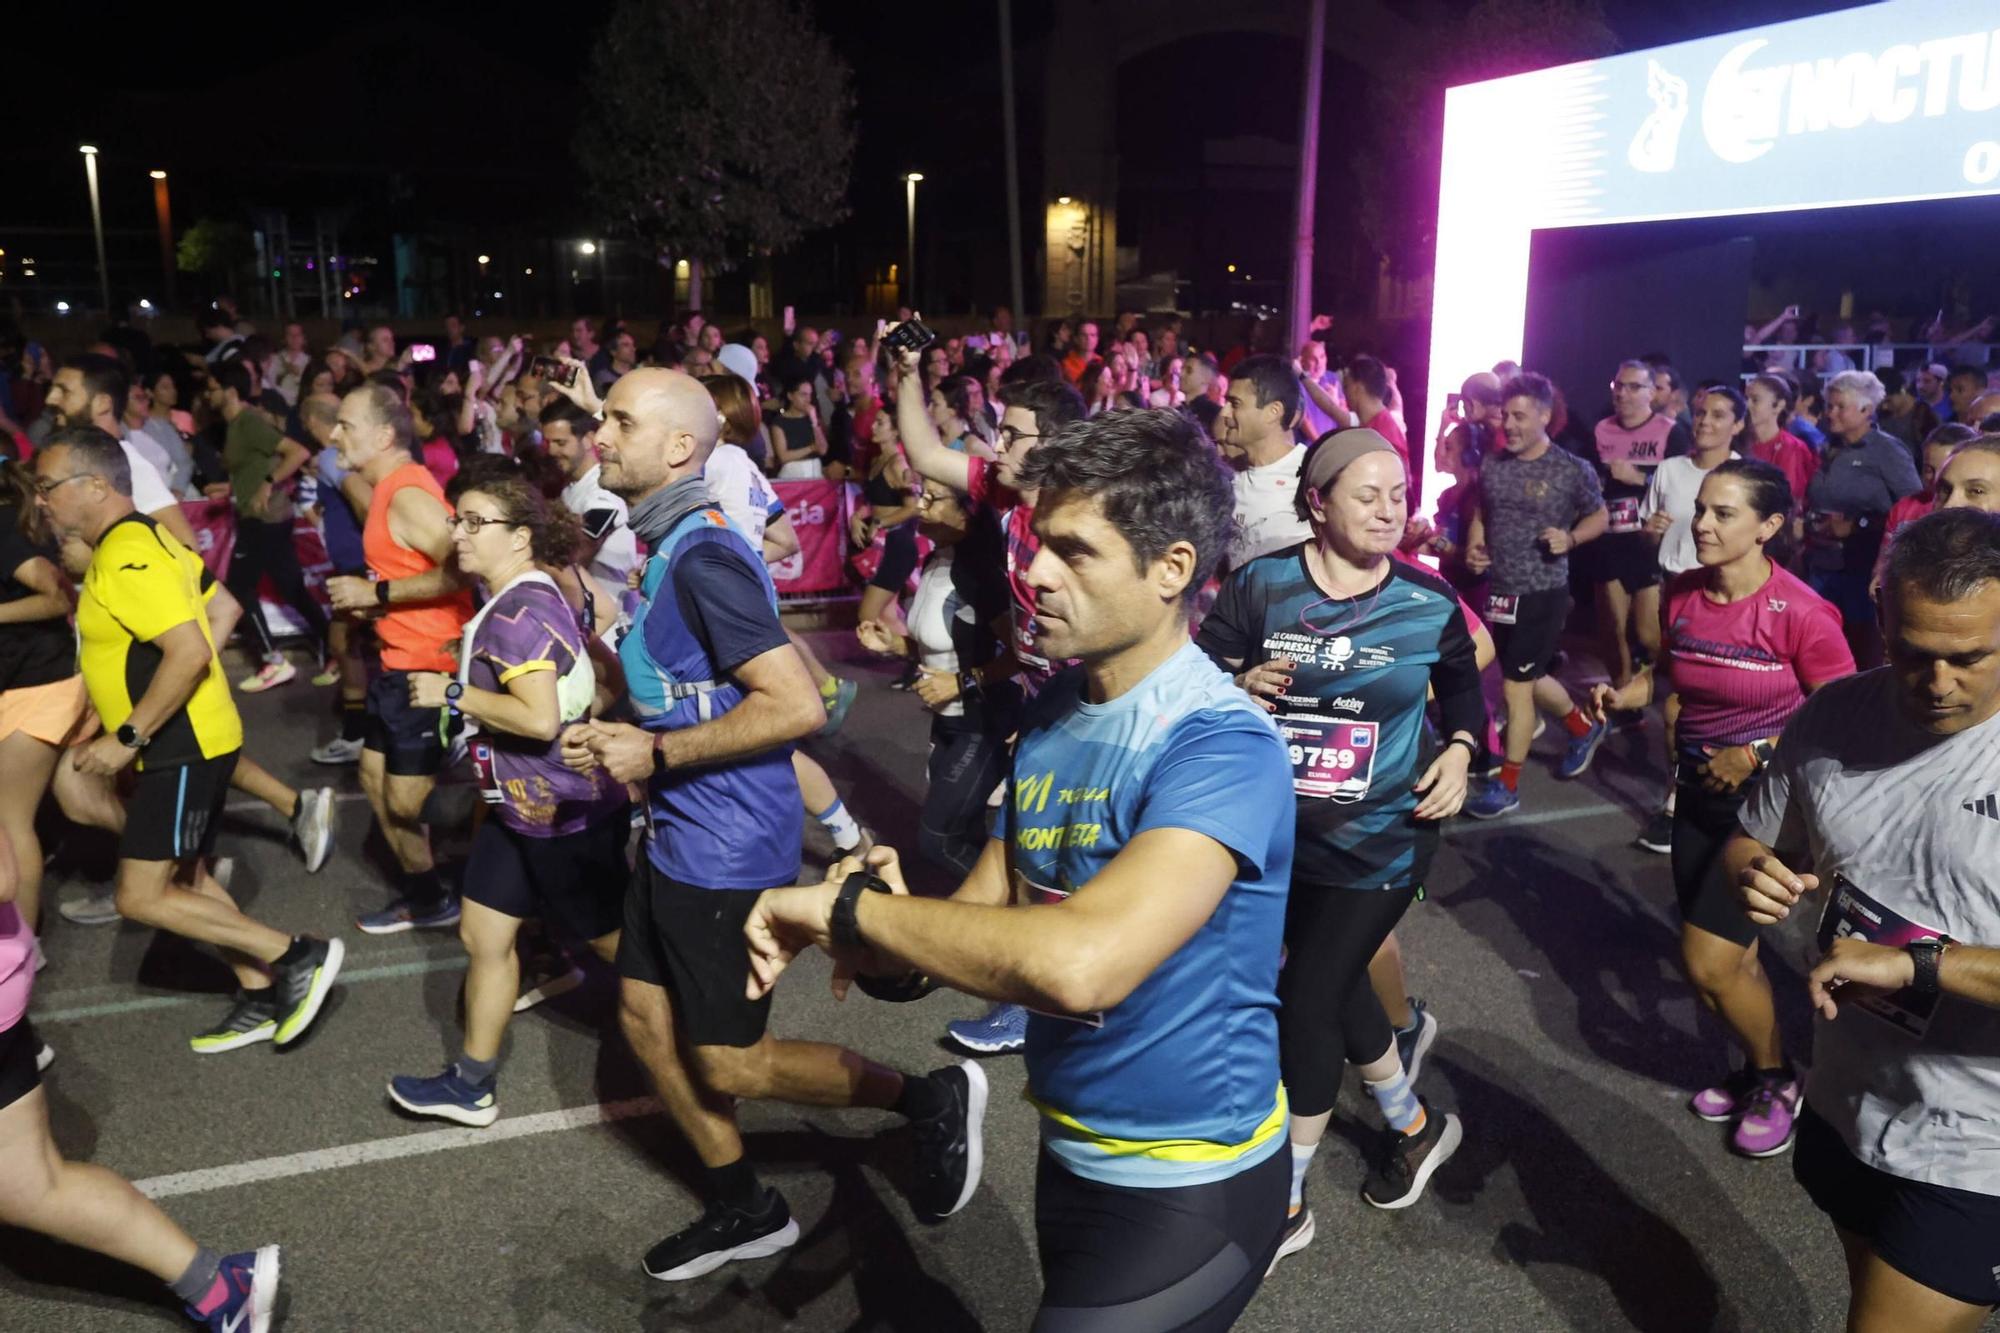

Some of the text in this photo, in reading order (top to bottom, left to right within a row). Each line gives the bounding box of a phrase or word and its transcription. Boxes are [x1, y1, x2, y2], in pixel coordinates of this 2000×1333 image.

[1263, 639, 1317, 653] EMPRESAS
[1280, 633, 1312, 643] CARRERA
[1312, 637, 1324, 645] DE
[1271, 650, 1316, 664] VALENCIA
[1288, 744, 1356, 769] 9759
